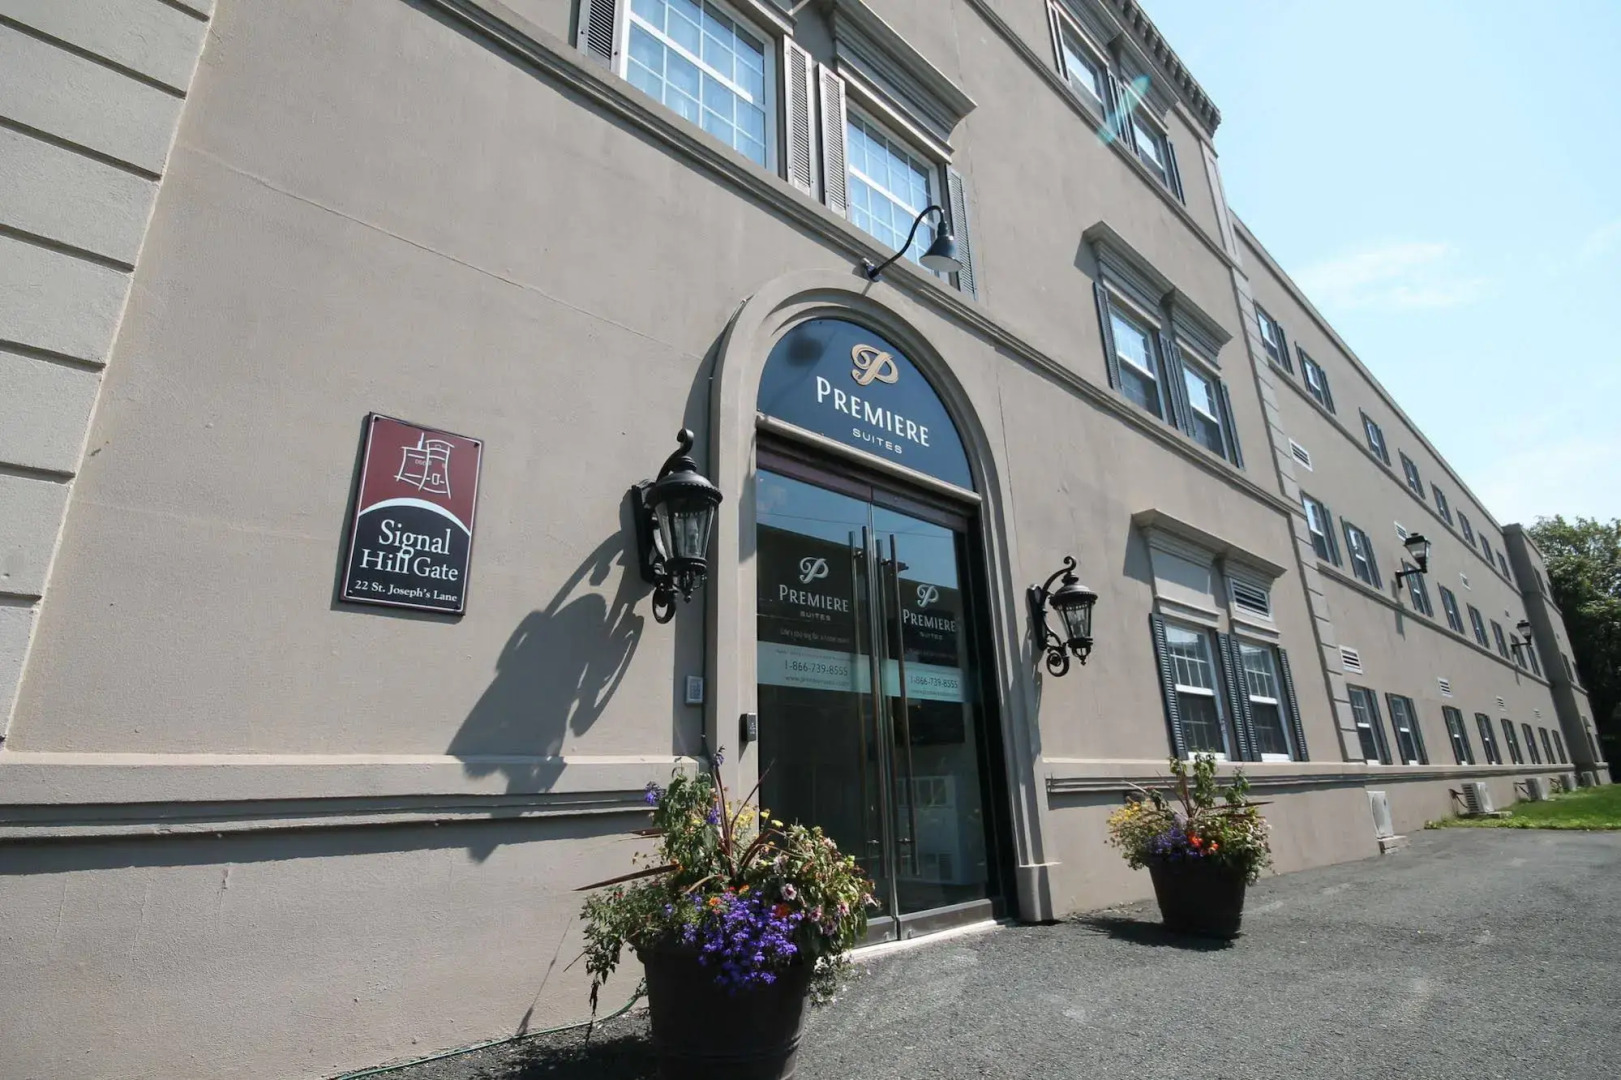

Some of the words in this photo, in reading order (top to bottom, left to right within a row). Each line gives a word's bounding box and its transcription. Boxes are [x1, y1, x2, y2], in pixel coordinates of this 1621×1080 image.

[816, 375, 930, 447] PREMIERE
[852, 428, 903, 454] SUITES
[378, 518, 451, 559] Signal
[360, 548, 410, 575] Hill
[413, 556, 459, 581] Gate
[355, 579, 369, 590] 22
[371, 581, 386, 593] St.
[388, 584, 431, 598] Joseph's
[434, 590, 458, 602] Lane
[779, 584, 849, 612] PREMIERE
[800, 610, 831, 622] SUITES
[902, 608, 956, 632] PREMIERE
